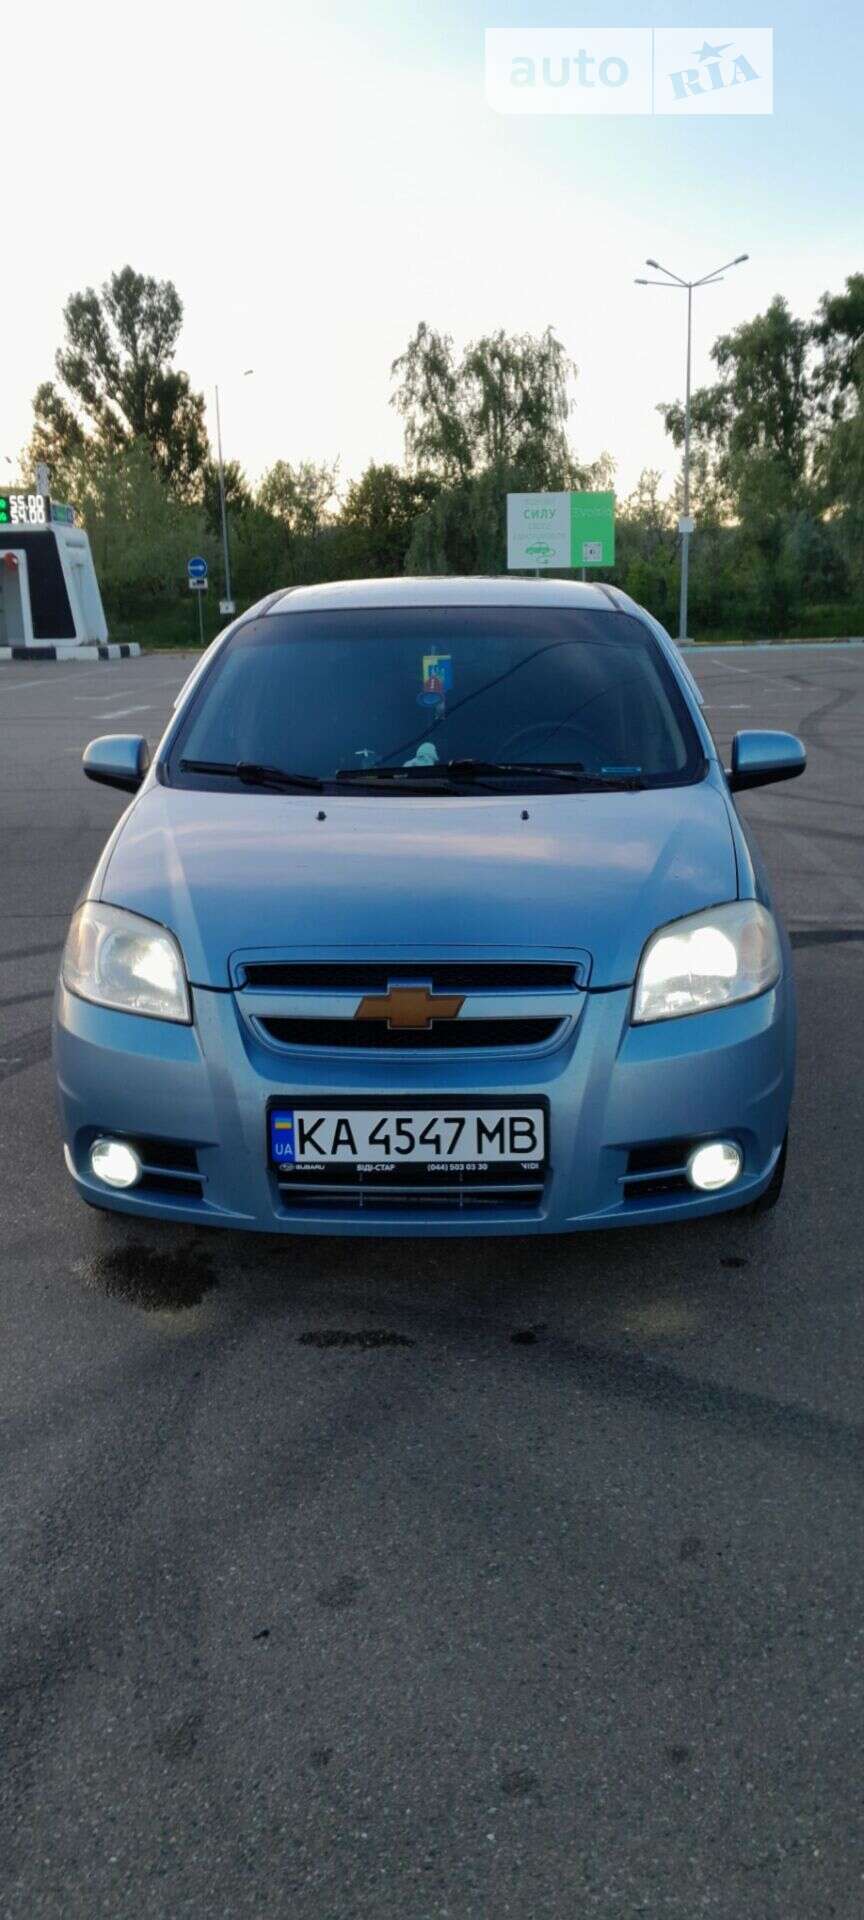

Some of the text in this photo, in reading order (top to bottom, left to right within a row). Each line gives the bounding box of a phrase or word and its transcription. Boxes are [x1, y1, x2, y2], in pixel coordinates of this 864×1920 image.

[297, 1116, 538, 1155] KA 4547 MB
[275, 1143, 294, 1156] UA
[295, 1163, 325, 1171] SUBARU
[427, 1163, 448, 1172] (044)
